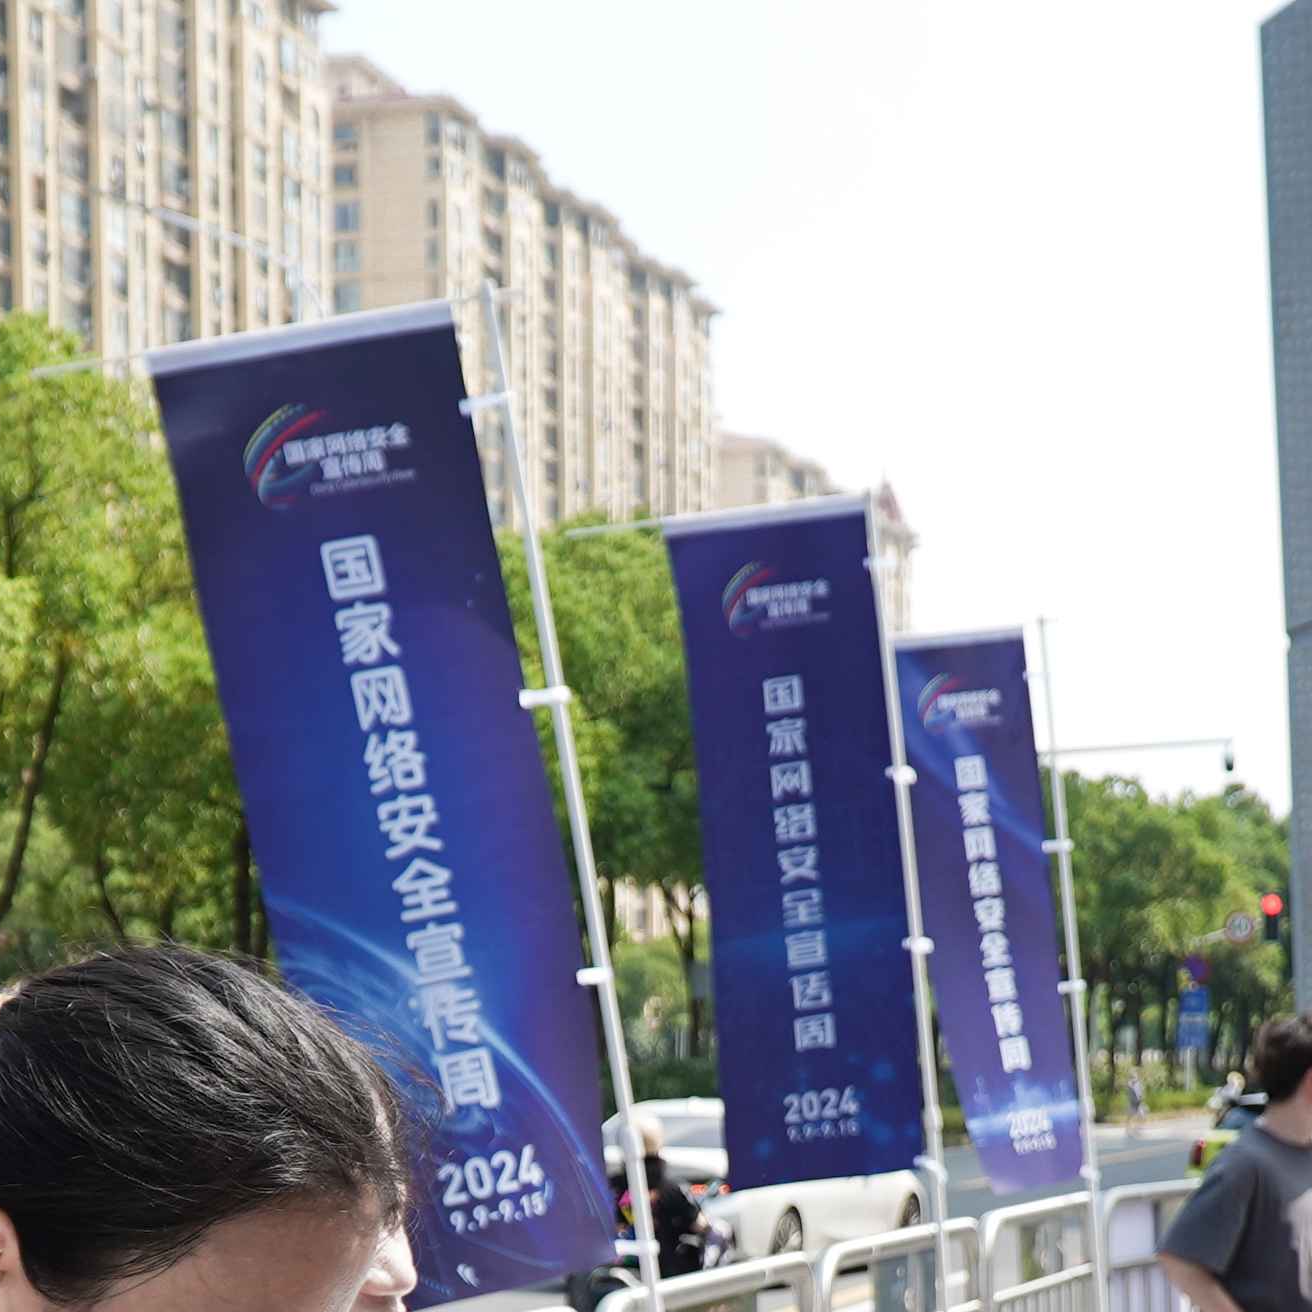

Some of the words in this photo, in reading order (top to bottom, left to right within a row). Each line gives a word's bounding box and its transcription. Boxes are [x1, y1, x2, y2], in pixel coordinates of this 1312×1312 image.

[320, 534, 502, 1112] 国家网络安全宣传周
[762, 673, 838, 1053] 国家网络安全宣传周
[783, 1084, 862, 1127] 2024
[1006, 1105, 1054, 1141] 2024
[438, 1143, 545, 1208] 2024
[449, 1190, 548, 1235] 9.9-9.15
